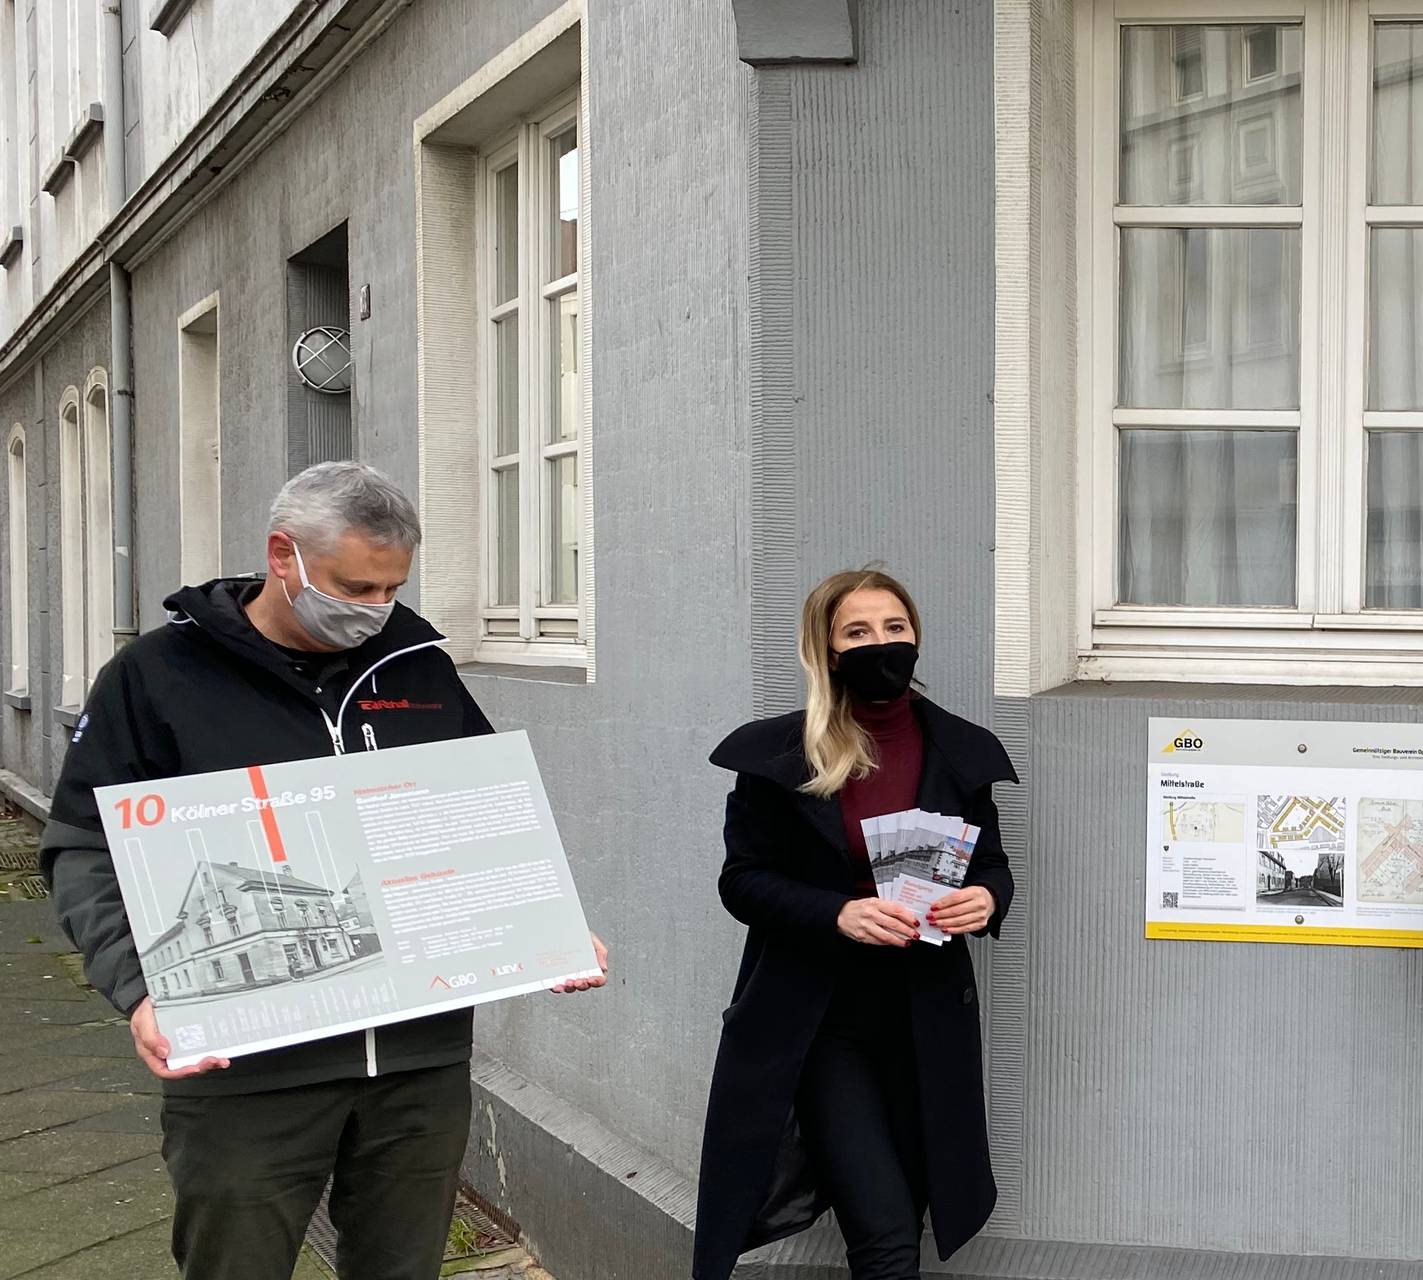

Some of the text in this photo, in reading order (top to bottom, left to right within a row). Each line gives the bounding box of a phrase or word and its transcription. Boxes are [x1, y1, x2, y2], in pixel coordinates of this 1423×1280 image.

[1174, 738, 1203, 749] GBO
[1161, 780, 1204, 788] Mittelstraße
[114, 794, 165, 830] 10
[170, 785, 337, 824] Kölner Straße 95
[449, 972, 477, 988] GBO
